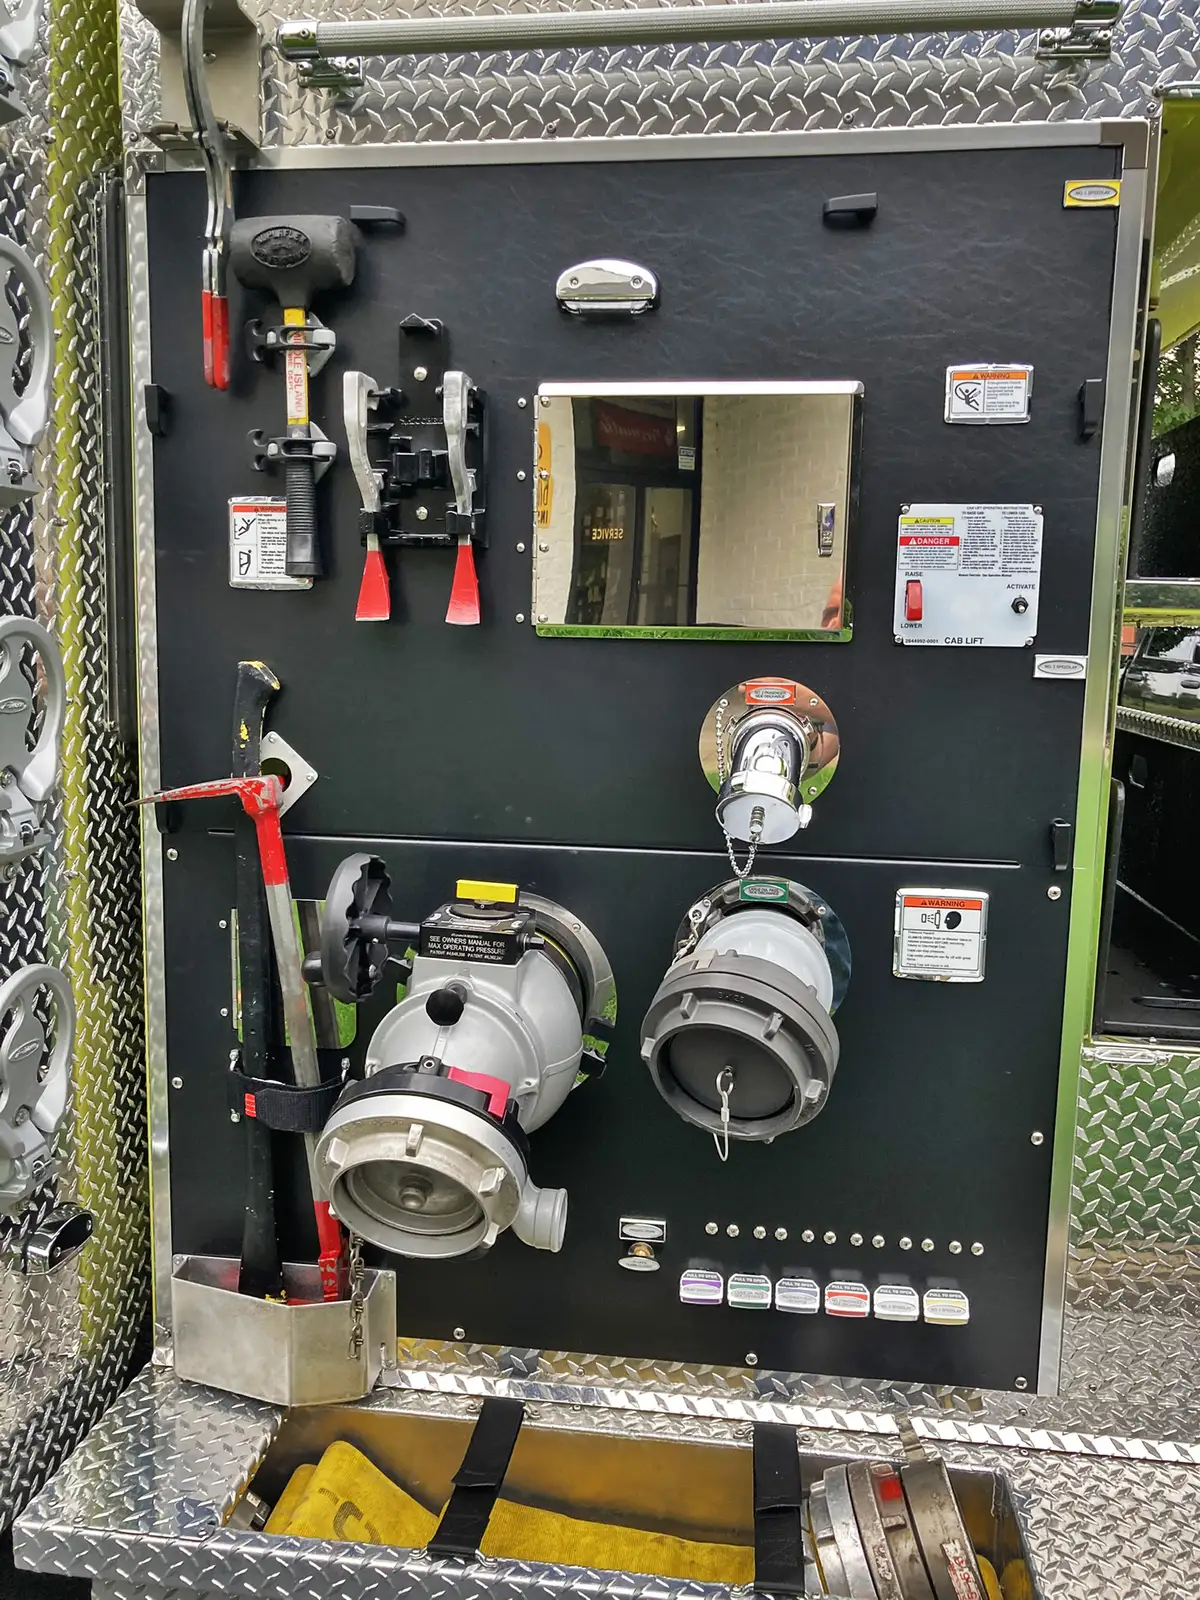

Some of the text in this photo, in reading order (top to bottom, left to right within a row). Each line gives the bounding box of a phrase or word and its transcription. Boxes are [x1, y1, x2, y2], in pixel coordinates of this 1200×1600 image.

[294, 374, 302, 412] ISLAND
[442, 944, 475, 952] OPERATING
[476, 946, 505, 955] PRESSURE
